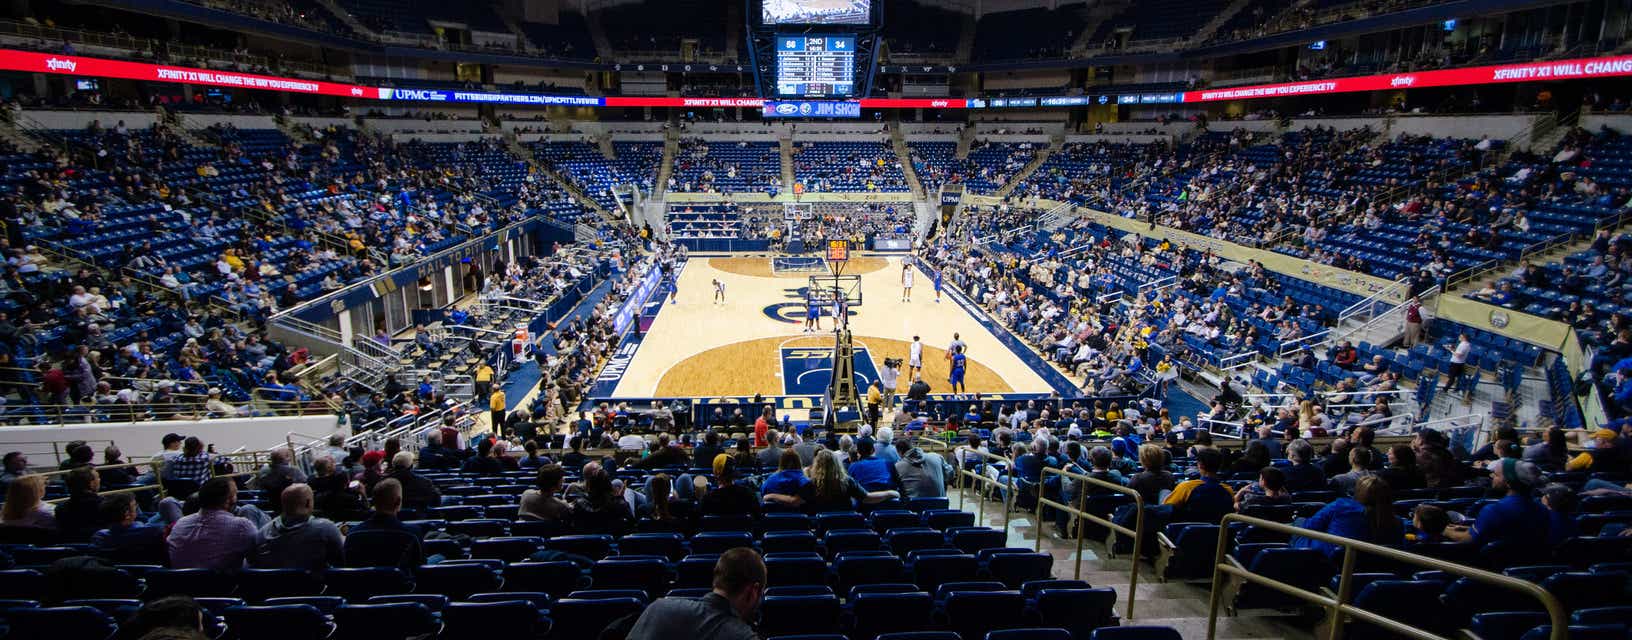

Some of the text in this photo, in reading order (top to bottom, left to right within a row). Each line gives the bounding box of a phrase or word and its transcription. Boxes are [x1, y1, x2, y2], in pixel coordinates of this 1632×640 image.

[834, 40, 846, 49] 34
[46, 57, 77, 72] xfinity
[1493, 66, 1537, 80] XFINITY
[1537, 66, 1552, 78] X1
[1553, 63, 1583, 76] WILL
[157, 68, 187, 80] XFINITY
[188, 71, 198, 81] X1
[198, 72, 215, 83] WILL
[215, 74, 243, 85] CHANGE
[243, 77, 256, 86] THE
[1391, 76, 1414, 88] xfinity
[395, 89, 430, 100] UPMC
[1233, 88, 1254, 97] CHANGE
[1277, 86, 1289, 95] YOU
[1289, 83, 1326, 94] EXPERIENCE
[1326, 82, 1336, 91] TV
[685, 99, 764, 107] XFINITY X1 WILL CHANGE
[815, 103, 834, 115] JIM
[418, 258, 445, 278] HAIL
[448, 250, 462, 266] TO
[596, 354, 632, 381] UPMC
